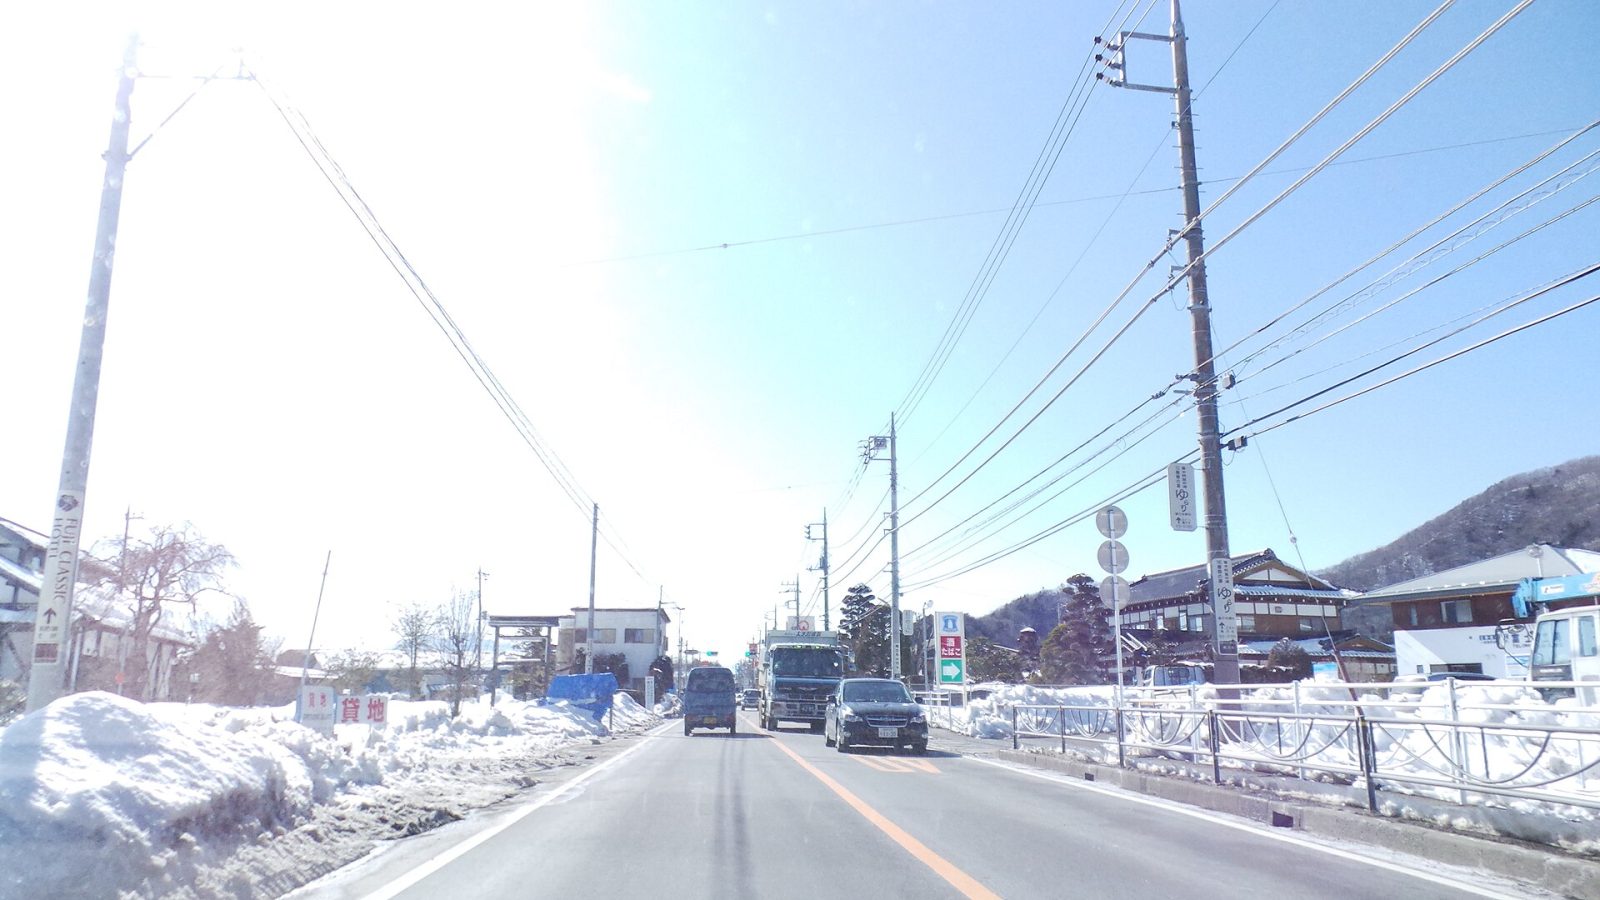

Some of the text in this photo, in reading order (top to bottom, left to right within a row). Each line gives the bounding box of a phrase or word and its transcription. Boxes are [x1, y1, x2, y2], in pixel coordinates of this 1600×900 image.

[53, 551, 72, 604] CLASSIC
[941, 648, 961, 656] たばこ
[341, 697, 385, 724] 貸地
